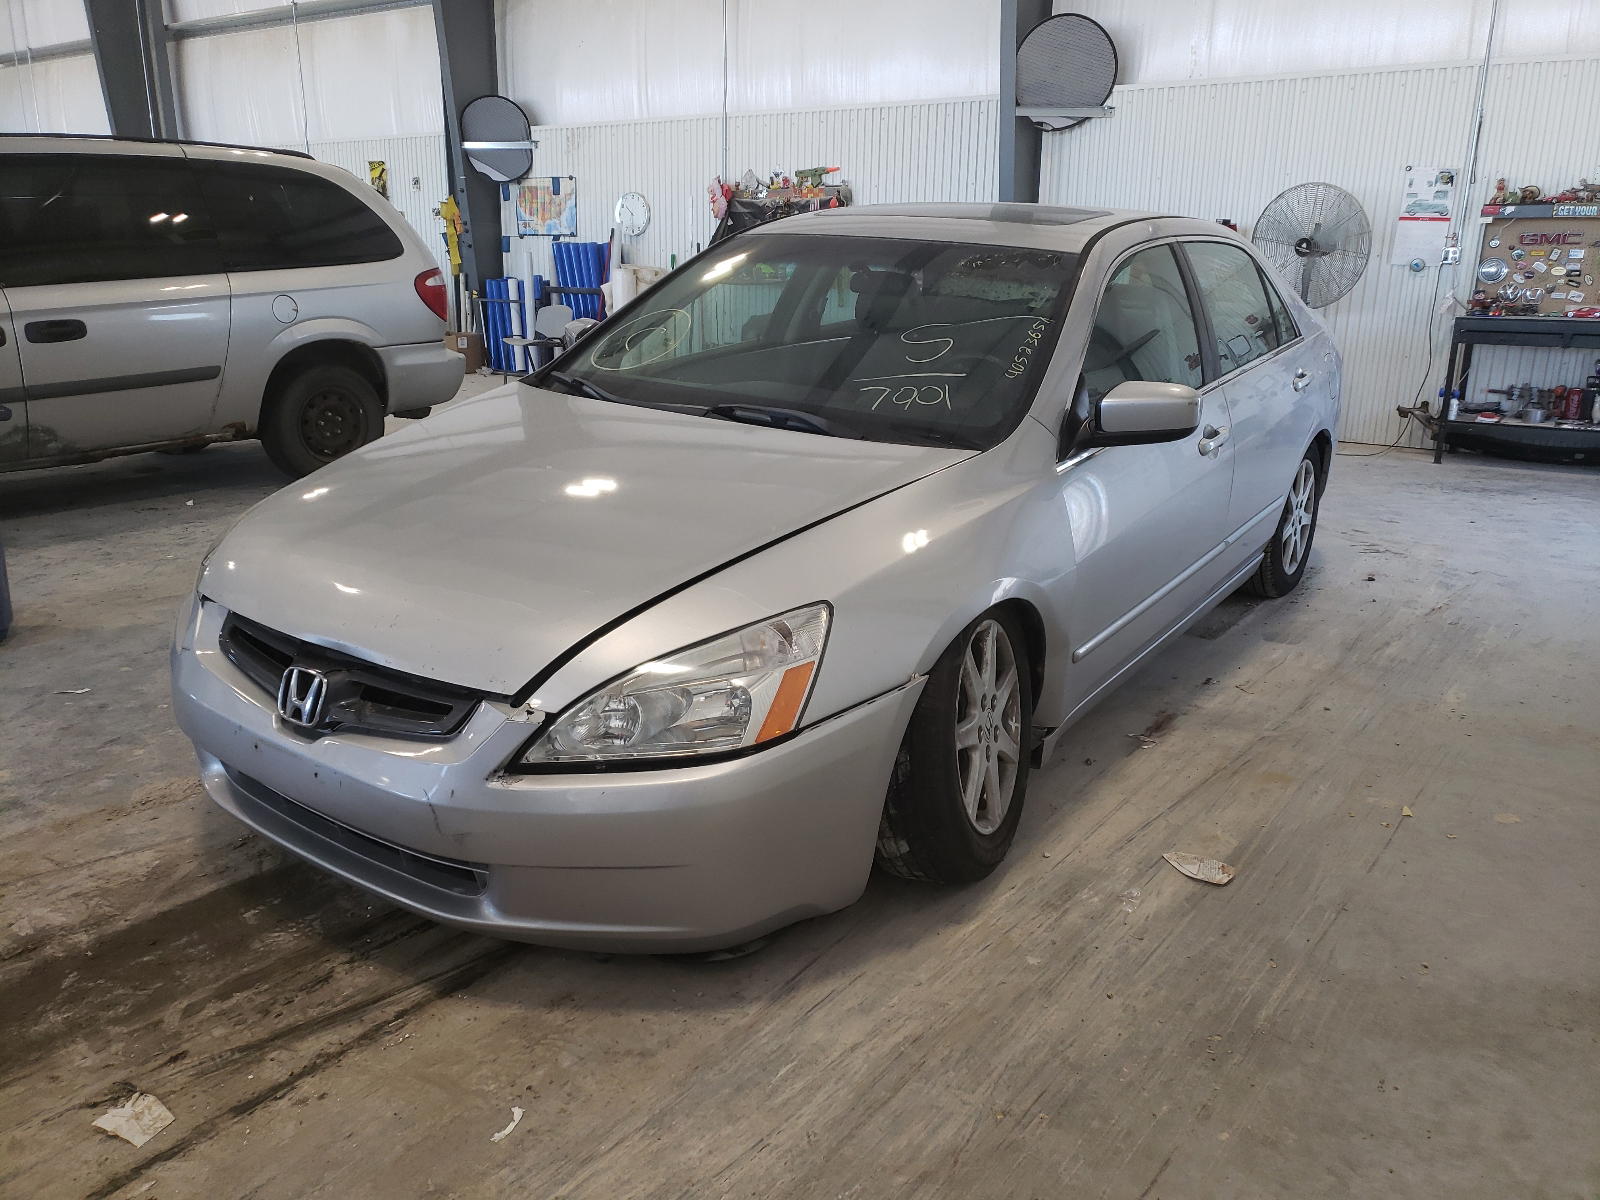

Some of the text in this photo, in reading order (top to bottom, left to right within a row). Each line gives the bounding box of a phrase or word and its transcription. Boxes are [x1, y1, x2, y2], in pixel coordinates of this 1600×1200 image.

[1558, 205, 1575, 216] GET
[1519, 232, 1585, 246] GMC
[859, 384, 952, 411] 7901
